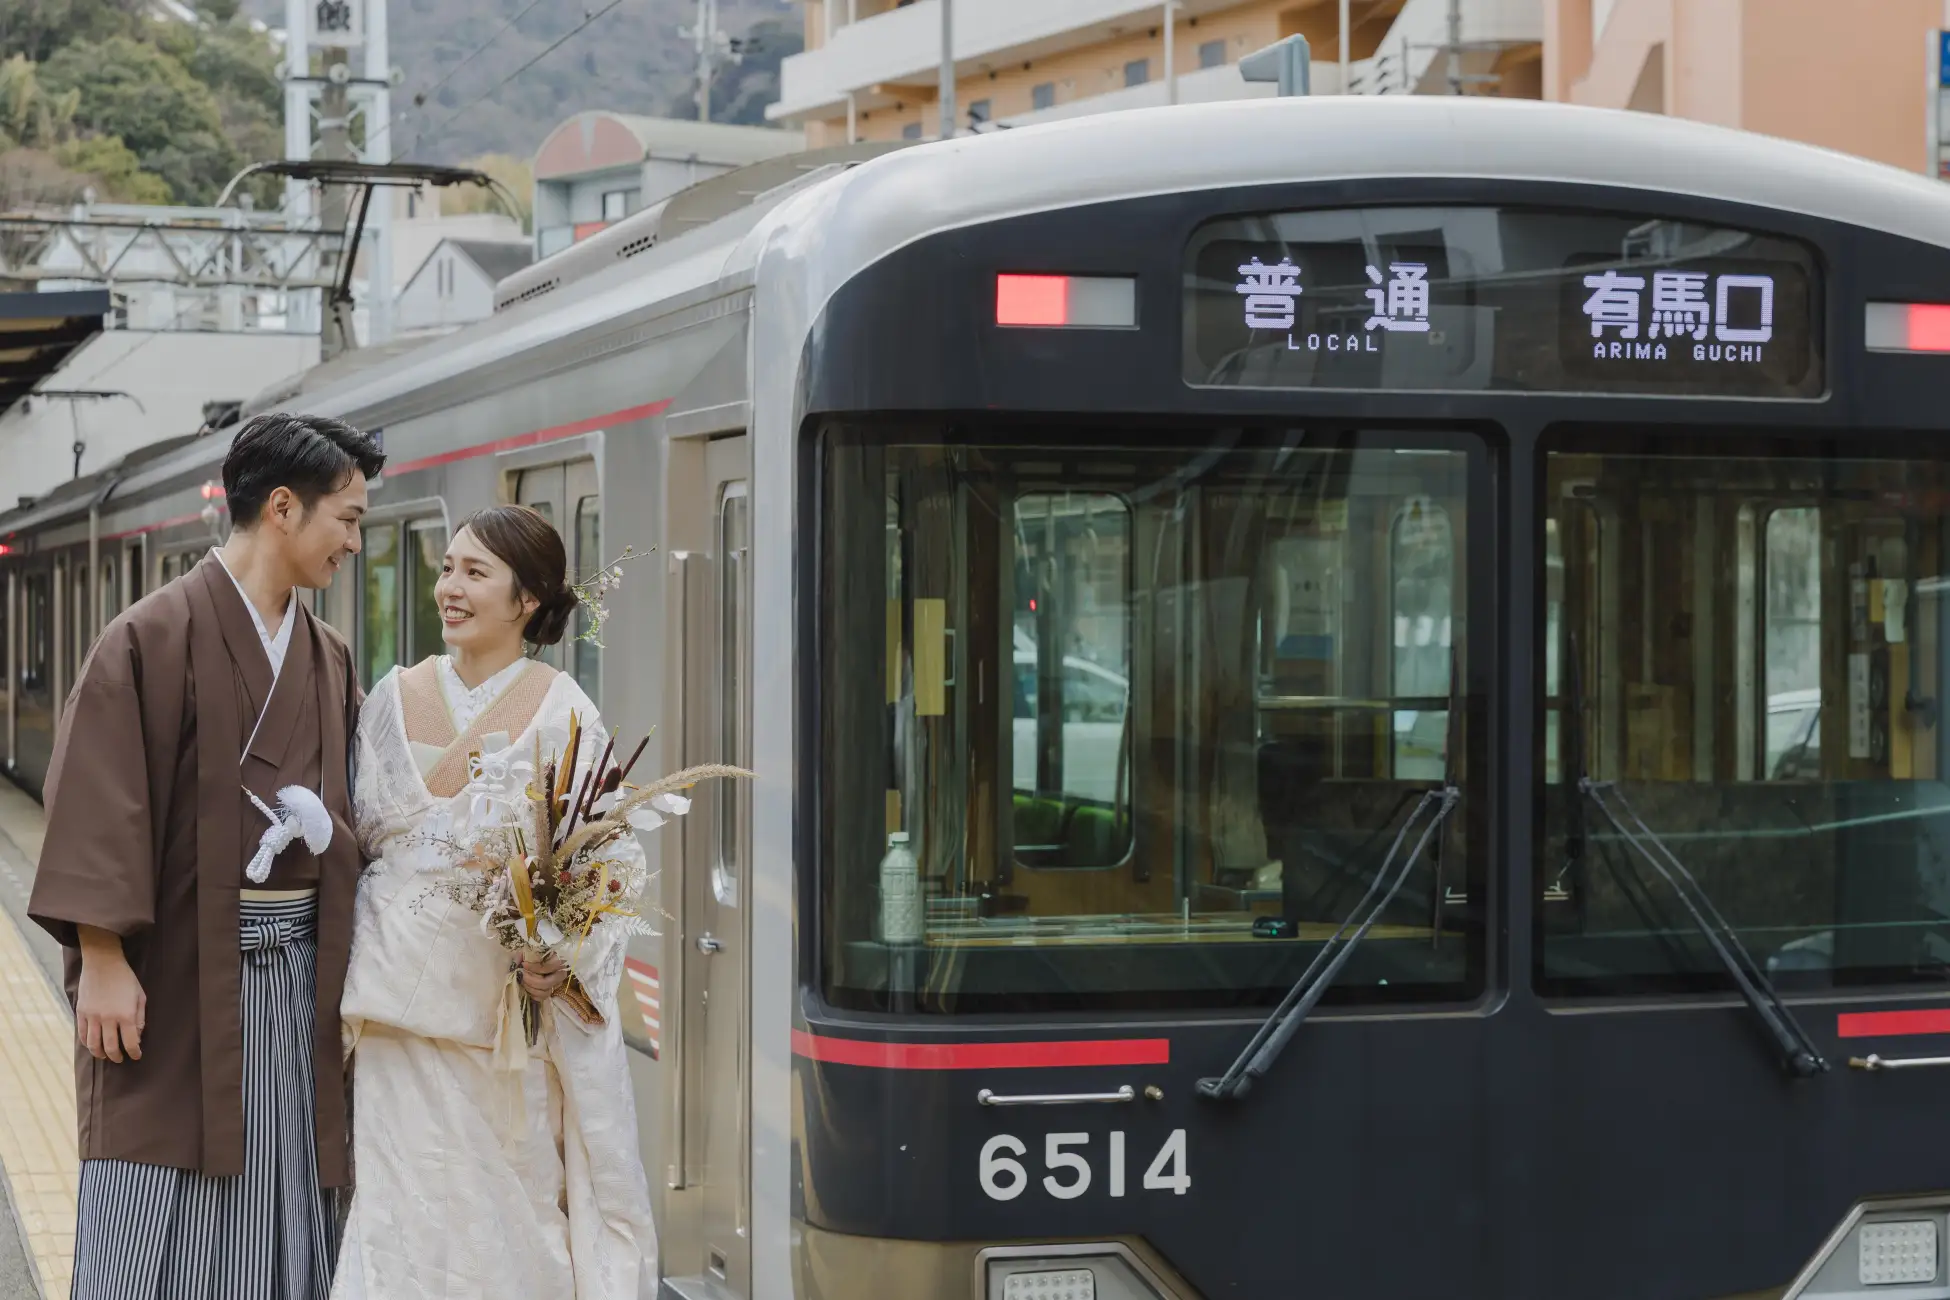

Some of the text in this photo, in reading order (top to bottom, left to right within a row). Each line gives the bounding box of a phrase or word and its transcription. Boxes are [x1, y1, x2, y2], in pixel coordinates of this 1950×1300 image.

[1236, 256, 1430, 331] 普通
[1582, 270, 1774, 342] 有馬口
[1287, 333, 1378, 351] LOCAL
[1594, 341, 1762, 363] ARIMA GUCHI
[979, 1128, 1192, 1201] 6514
